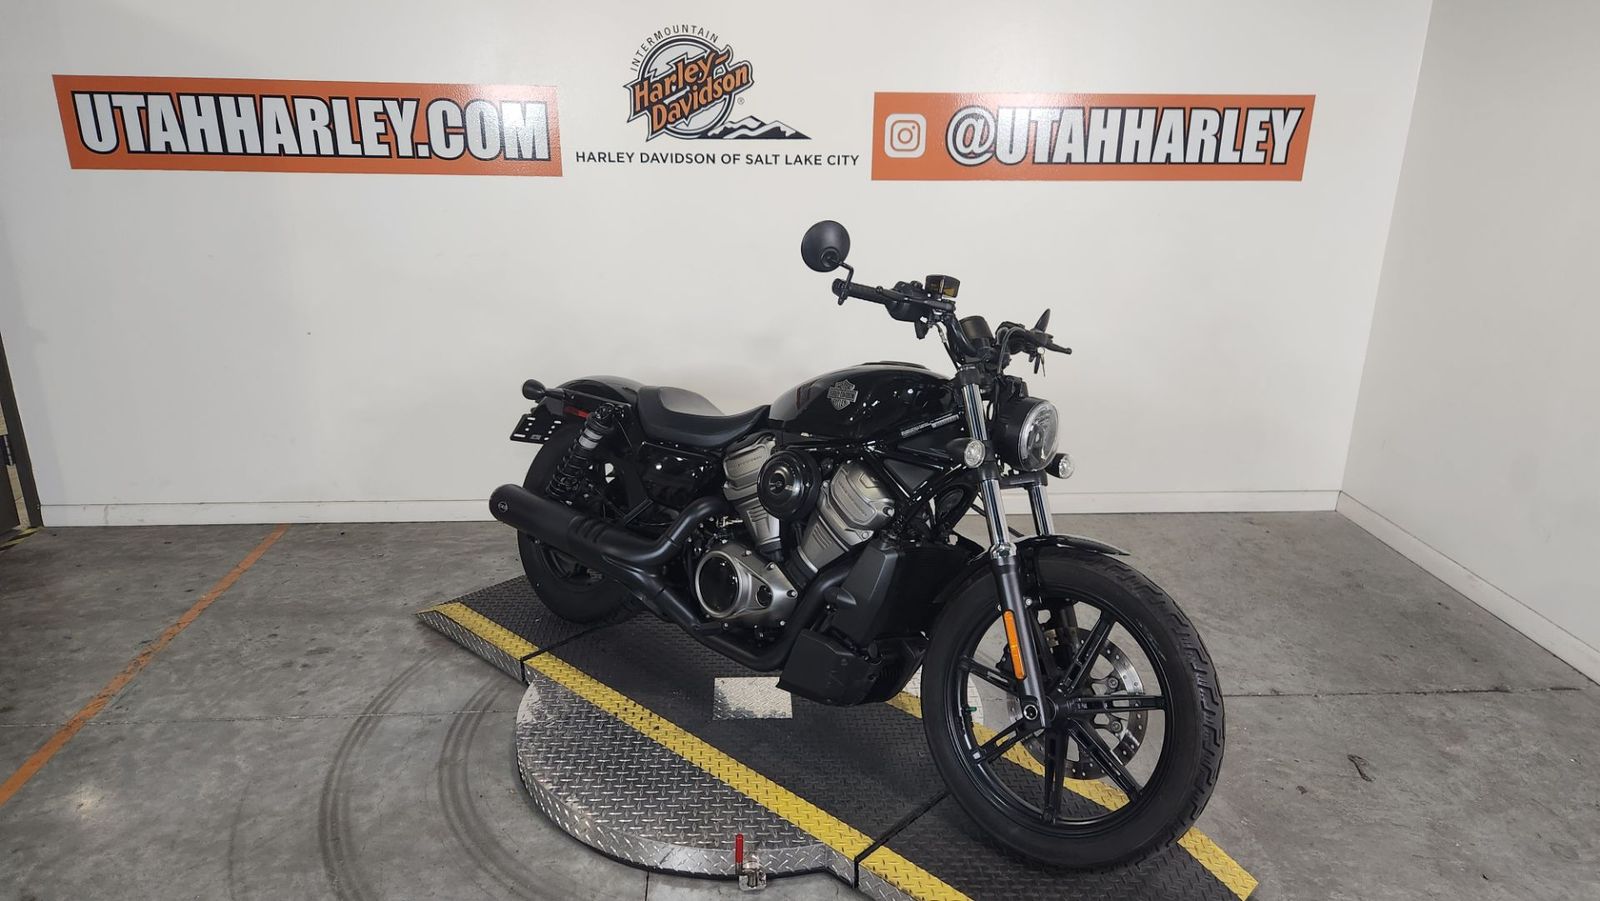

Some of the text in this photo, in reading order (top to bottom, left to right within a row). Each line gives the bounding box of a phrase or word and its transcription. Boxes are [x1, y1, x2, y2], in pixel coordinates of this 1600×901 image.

[630, 24, 719, 71] INTERMOUNTAIN
[71, 91, 551, 161] UTAHHARLEY.COM
[650, 65, 750, 134] Davidson
[576, 151, 860, 167] HARLEY DAVIDSON OF SALT LAKE CITY
[945, 105, 1306, 166] @UTAHHARLEY
